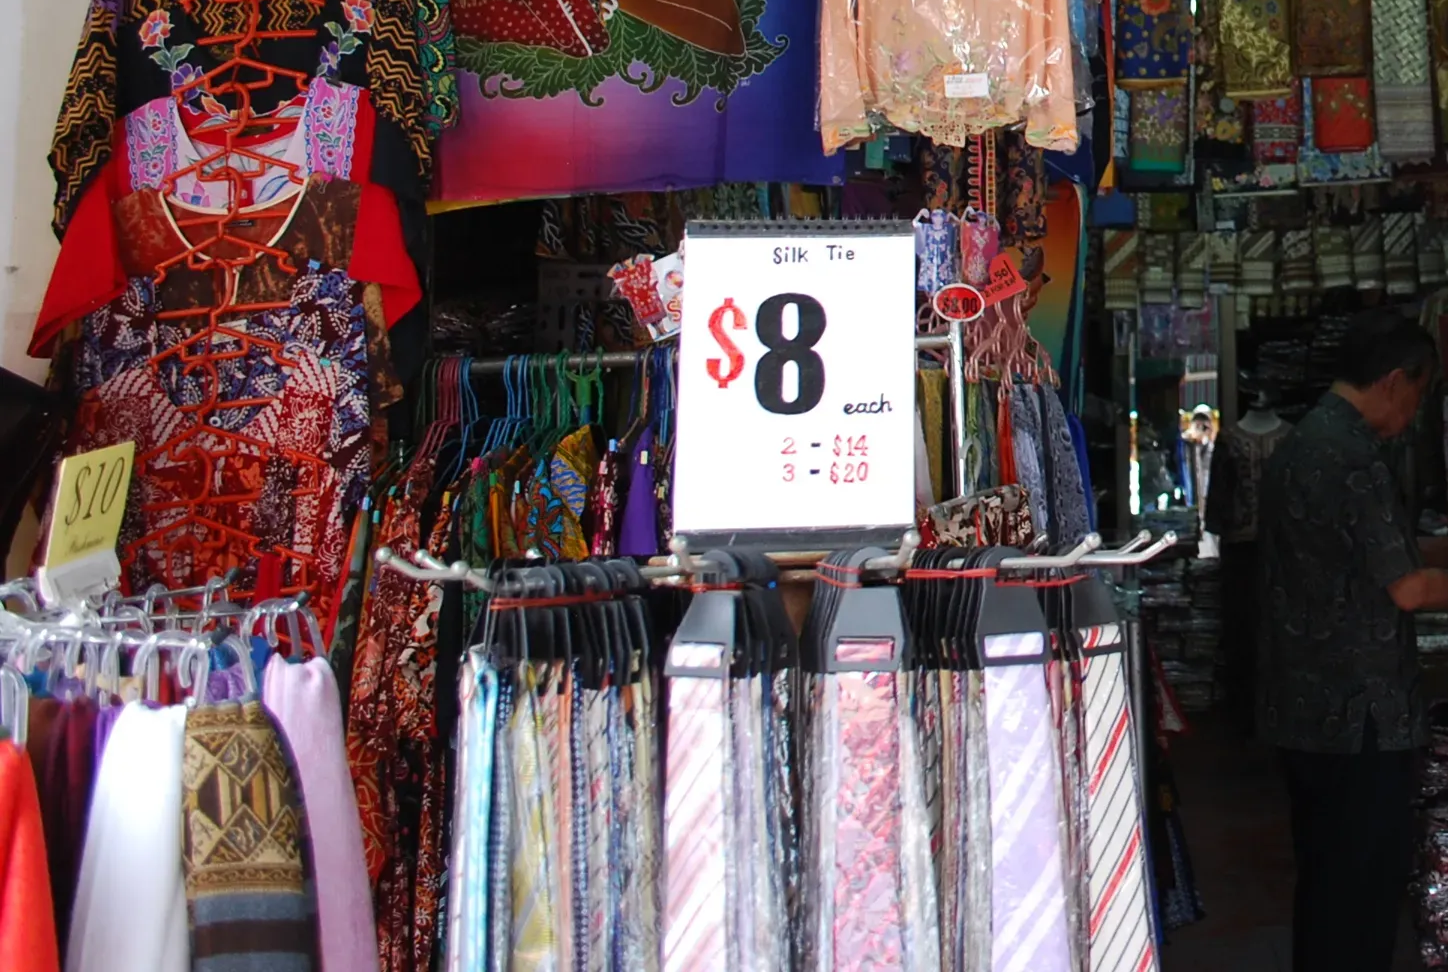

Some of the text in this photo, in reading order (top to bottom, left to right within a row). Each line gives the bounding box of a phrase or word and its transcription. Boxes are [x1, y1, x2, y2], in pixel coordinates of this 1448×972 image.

[773, 244, 855, 265] Silk Tie
[705, 292, 828, 416] $8
[843, 393, 893, 415] each
[780, 436, 797, 455] 2
[832, 433, 869, 457] $14
[782, 462, 796, 482] 3
[829, 461, 869, 484] $20
[65, 456, 125, 527] $10
